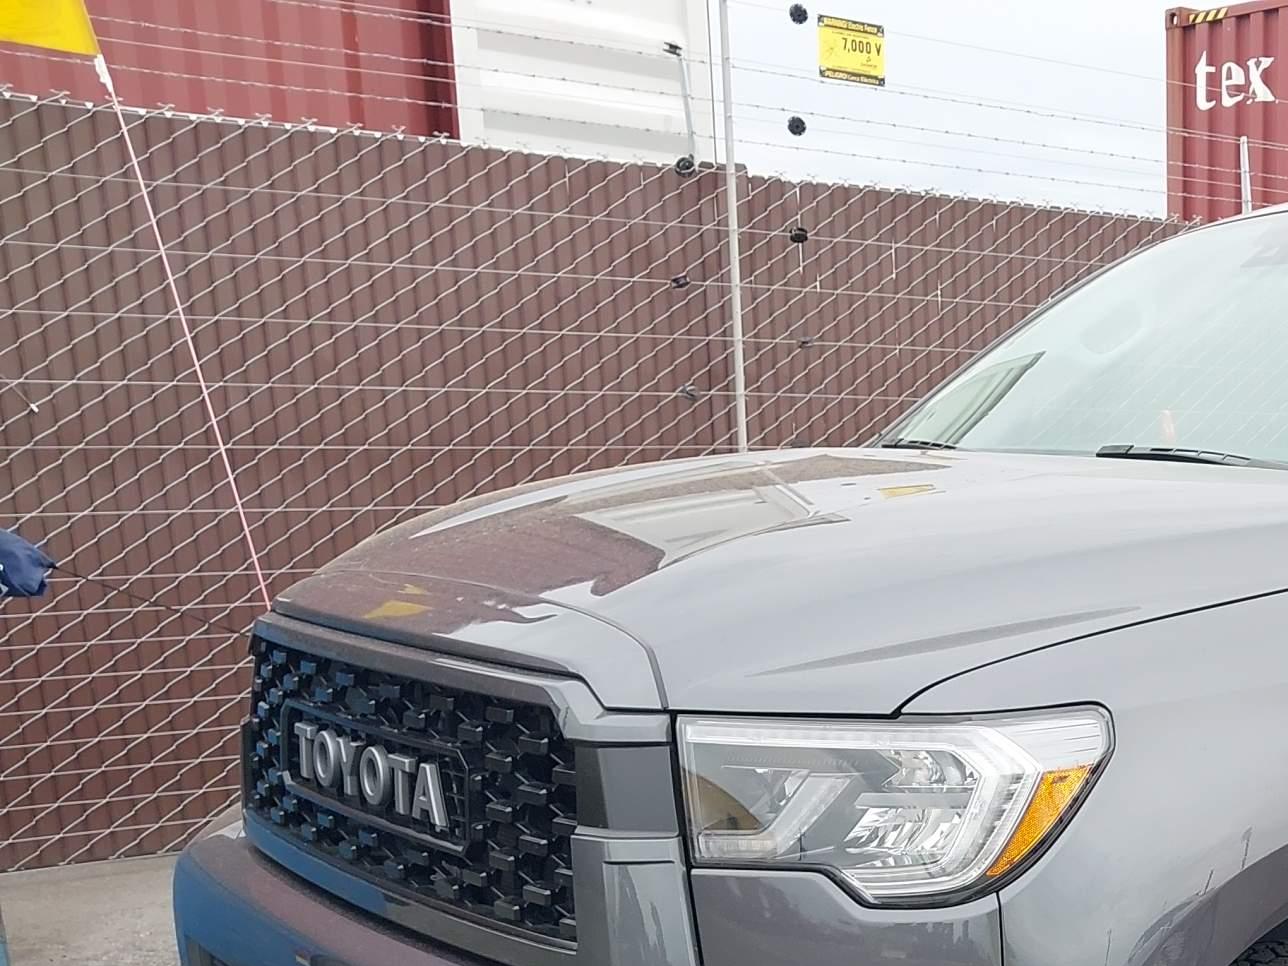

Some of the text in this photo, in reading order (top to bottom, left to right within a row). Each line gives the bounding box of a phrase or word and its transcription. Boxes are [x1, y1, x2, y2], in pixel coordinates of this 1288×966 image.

[842, 37, 882, 56] 7,000 V
[1195, 50, 1276, 111] tex
[294, 721, 449, 828] TOYOTA
